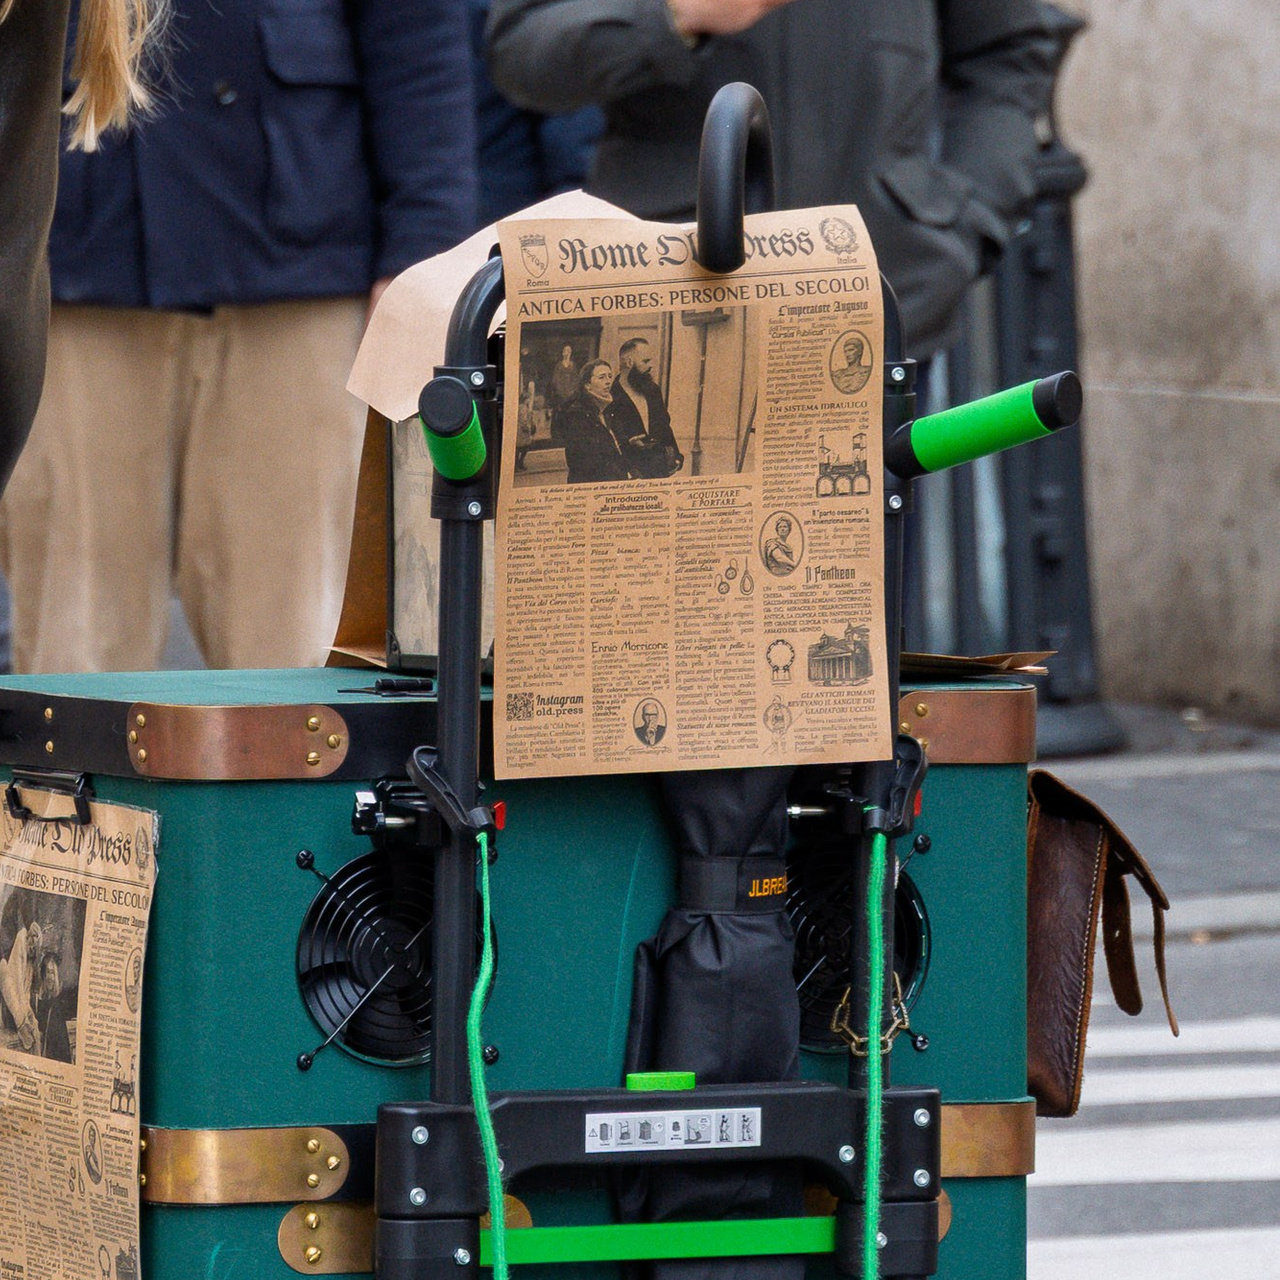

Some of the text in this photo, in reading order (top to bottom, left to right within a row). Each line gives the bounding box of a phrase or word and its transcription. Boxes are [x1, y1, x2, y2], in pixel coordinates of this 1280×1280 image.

[558, 238, 651, 274] Rome
[527, 279, 550, 287] Roma
[518, 276, 869, 317] ANTICA FORBES: PERSONE DEL SECOLO!
[784, 404, 819, 413] SISTEMA
[821, 401, 867, 410] IDRAULICO
[605, 495, 658, 504] Introduzione
[688, 490, 741, 500] ACQUISTARE
[699, 498, 736, 507] PORTARE
[814, 564, 856, 584] Pantheon
[591, 641, 669, 653] Ennio Morricone
[536, 694, 584, 708] Instagram
[536, 707, 584, 718] old.press
[86, 824, 132, 866] Press
[52, 876, 89, 899] PERSONE
[91, 886, 109, 903] DEL
